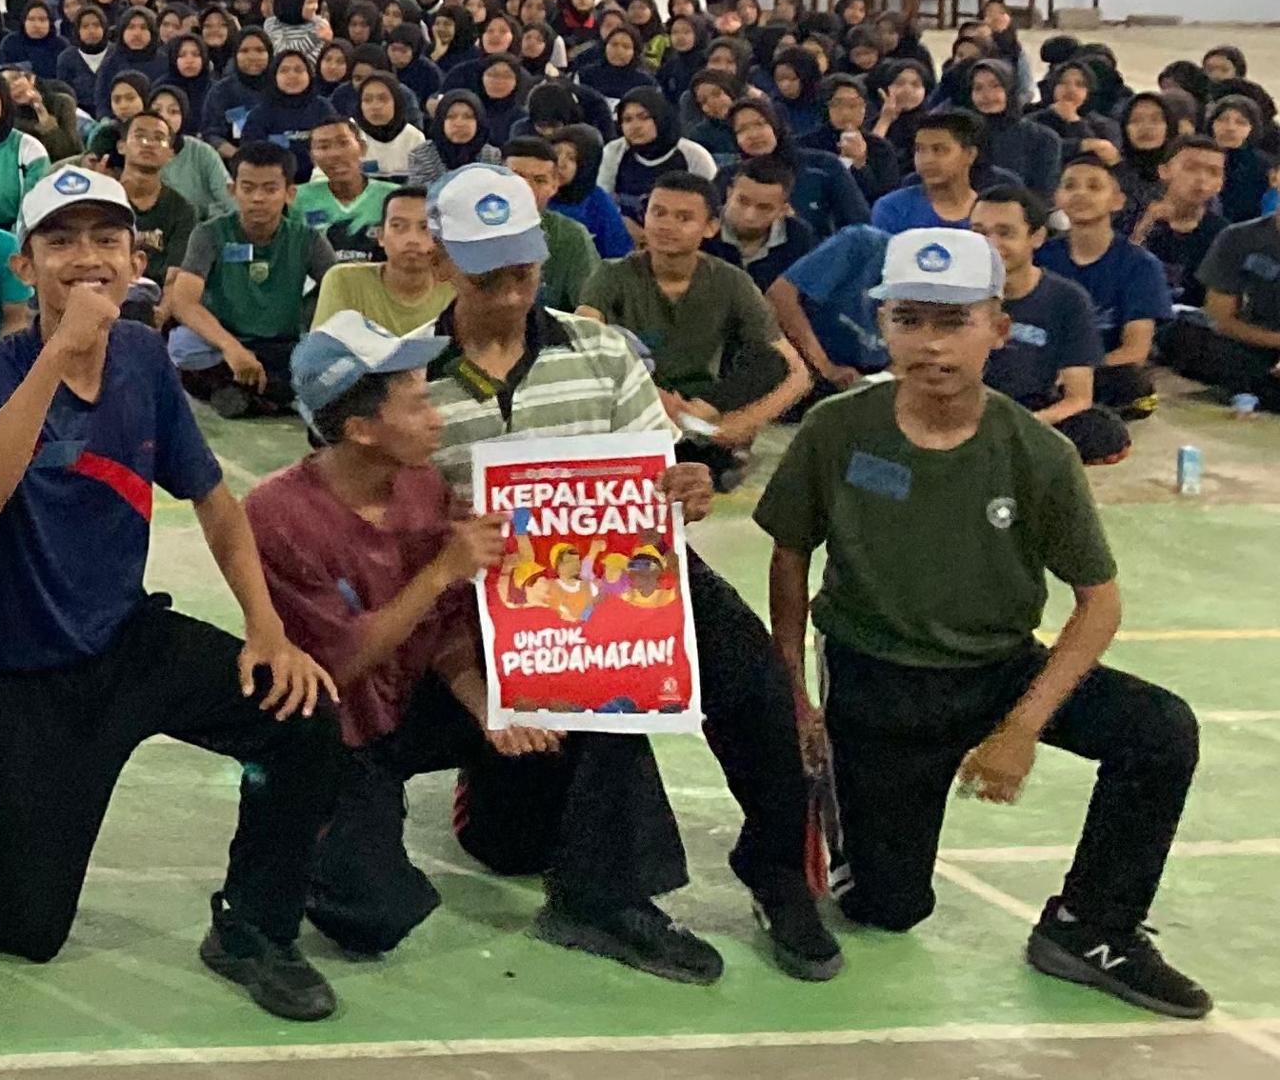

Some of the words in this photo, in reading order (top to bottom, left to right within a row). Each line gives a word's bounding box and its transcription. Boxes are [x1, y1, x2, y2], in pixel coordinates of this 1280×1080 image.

[490, 478, 667, 512] KEPALKAN
[513, 627, 587, 649] UNTUK
[501, 635, 676, 677] PERDAMAIAN!
